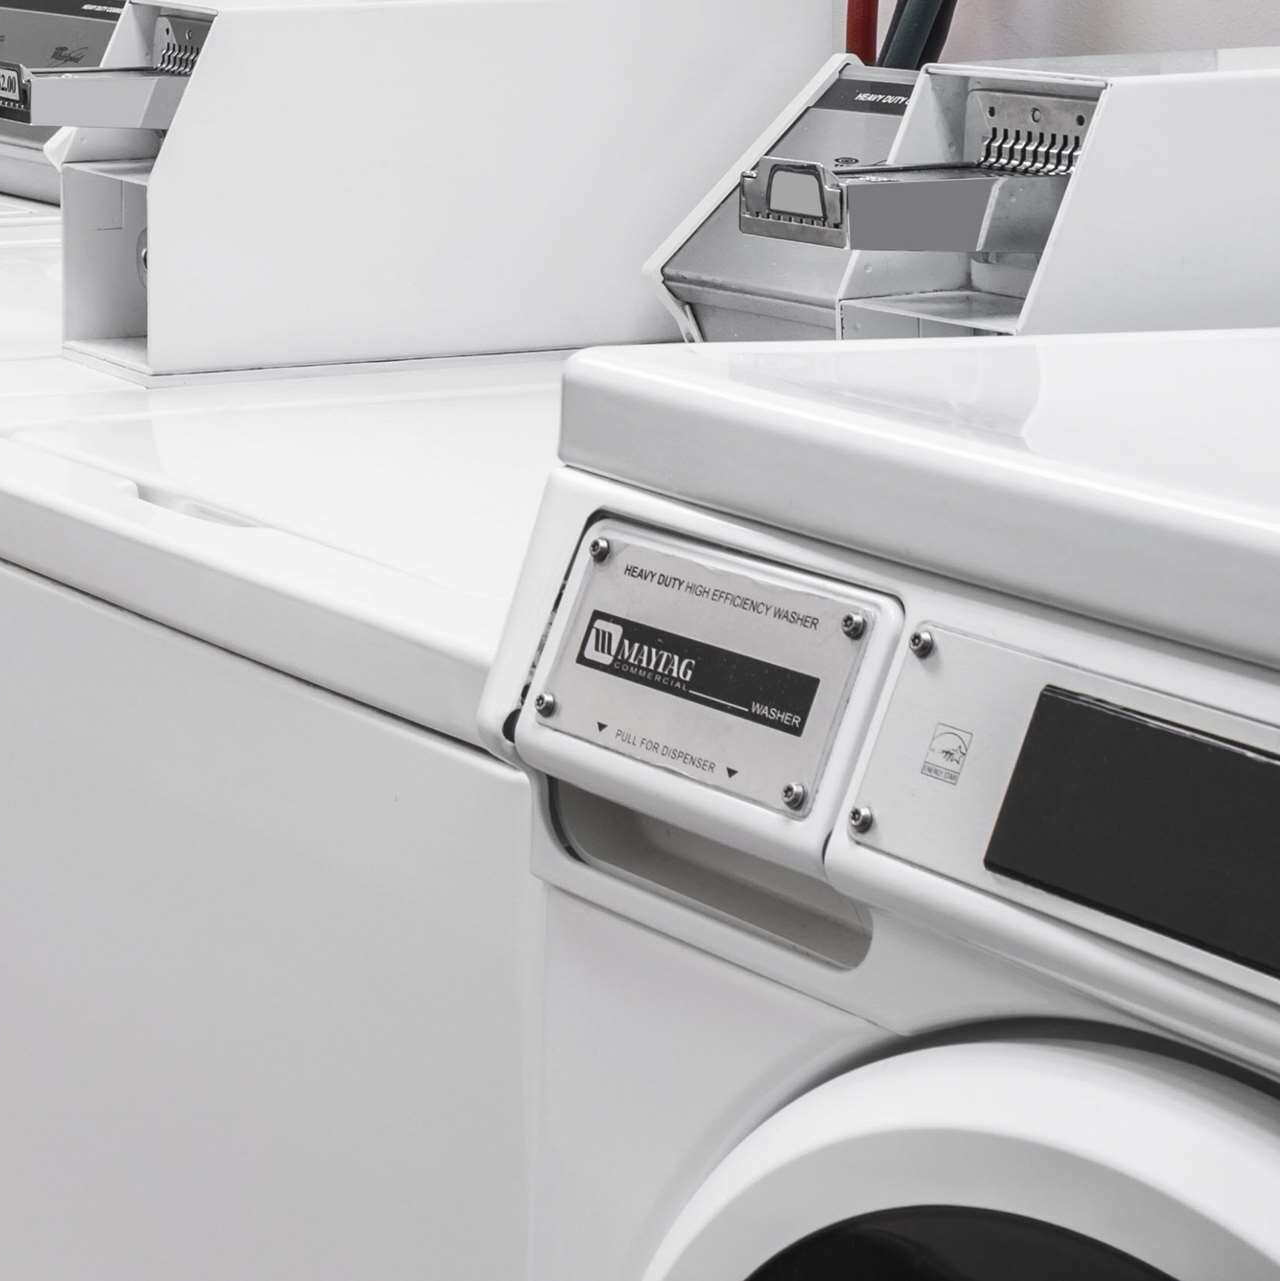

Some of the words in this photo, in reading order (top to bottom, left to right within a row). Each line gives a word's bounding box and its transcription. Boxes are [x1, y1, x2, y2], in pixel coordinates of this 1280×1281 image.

[882, 95, 907, 104] DUTY
[623, 563, 657, 583] HEAVY
[656, 573, 685, 591] DUTY
[685, 581, 711, 600] HIGH
[711, 588, 772, 616] EFFICIENCY
[772, 606, 820, 631] WASHER
[617, 638, 696, 682] MAYTAG
[613, 661, 689, 692] COMMERCIAL
[750, 701, 802, 729] WASHER
[615, 728, 637, 747] PULL
[640, 737, 659, 754] FOR
[661, 745, 717, 773] DISPENSER
